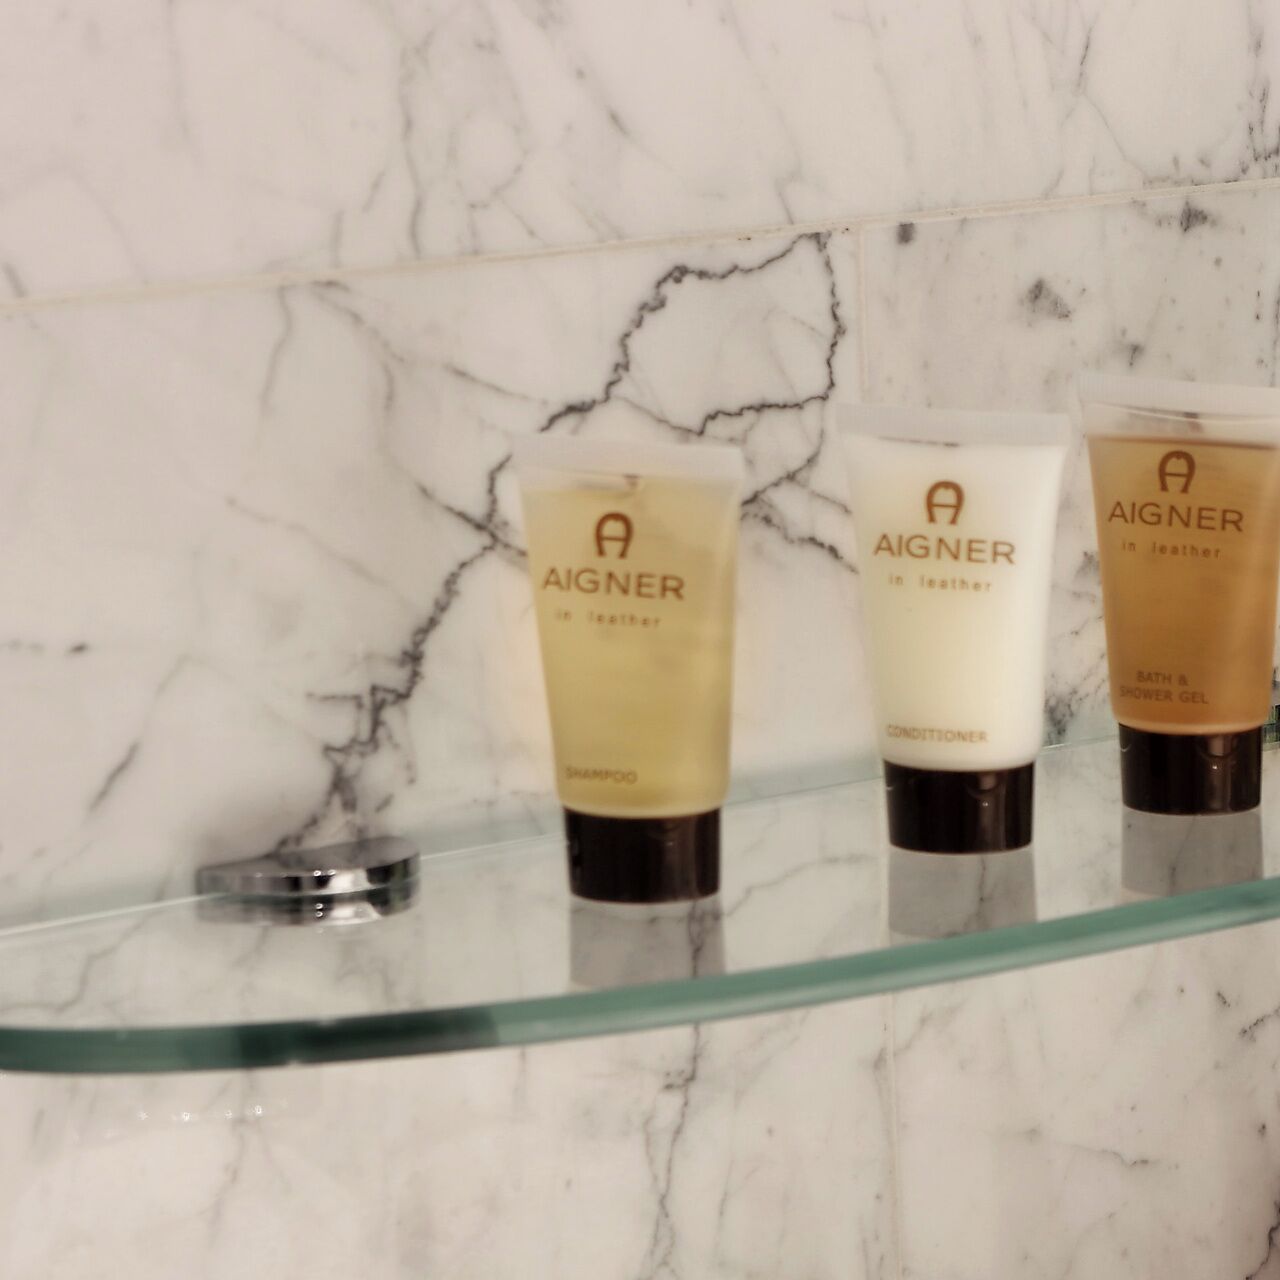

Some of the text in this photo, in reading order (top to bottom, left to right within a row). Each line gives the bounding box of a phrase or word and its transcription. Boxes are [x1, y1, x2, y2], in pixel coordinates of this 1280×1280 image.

[1108, 501, 1244, 532] AIGNER
[873, 533, 1016, 566] AIGNER
[1121, 541, 1222, 559] in leather
[541, 567, 686, 601] AIGNER
[889, 574, 992, 594] in leather
[556, 608, 662, 630] in leather
[1137, 671, 1189, 686] BATH &
[1119, 687, 1209, 705] SHOWER GEL
[886, 724, 989, 745] CONDITIONER
[564, 766, 637, 785] SHAMPOO
